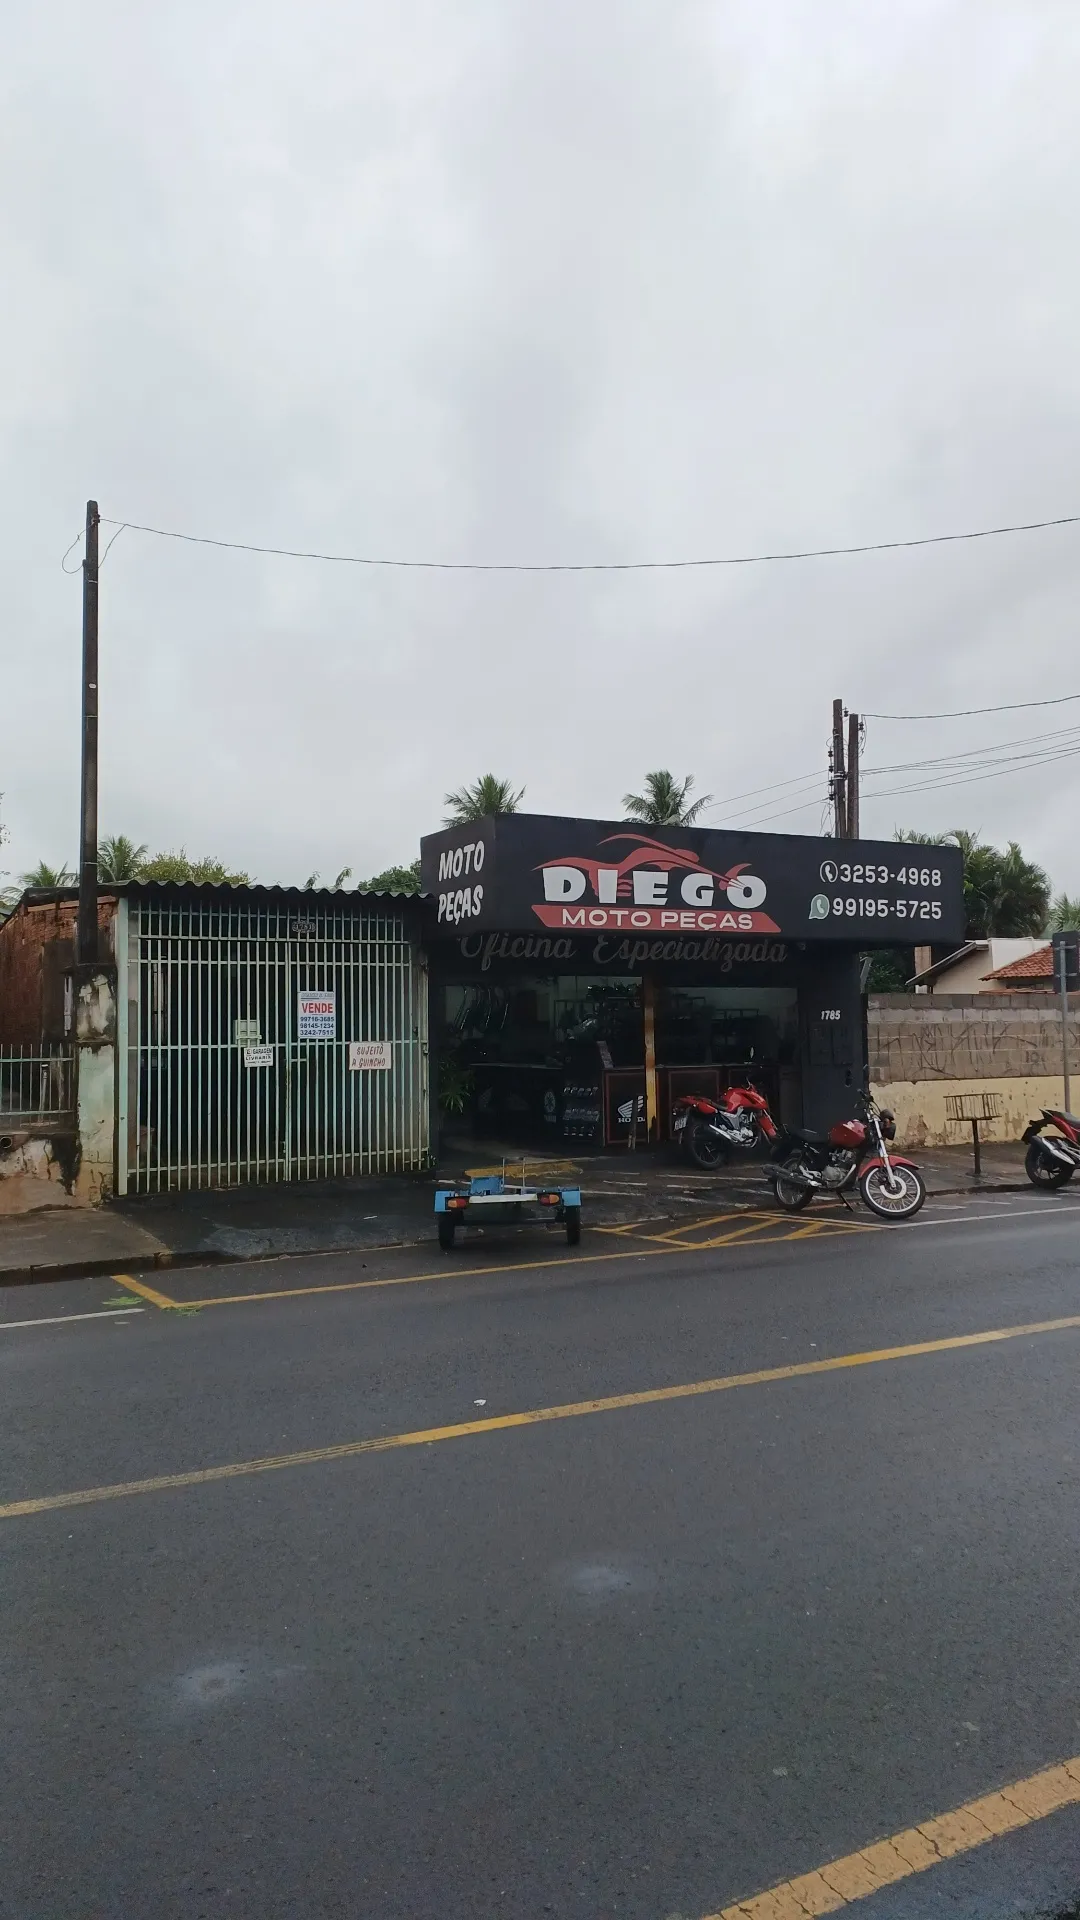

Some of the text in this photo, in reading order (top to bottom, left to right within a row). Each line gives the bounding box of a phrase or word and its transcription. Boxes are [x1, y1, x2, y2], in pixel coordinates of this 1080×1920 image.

[438, 840, 485, 882] MOTO
[542, 865, 767, 909] DIEGO
[840, 863, 942, 887] 3253-4968
[437, 884, 484, 926] PEÇAS
[832, 896, 942, 920] 99195-5725
[562, 908, 753, 931] MOTO PEÇAS
[457, 932, 788, 973] Oficina Especializada
[301, 1003, 333, 1014] VENDE
[821, 1009, 841, 1021] 1785
